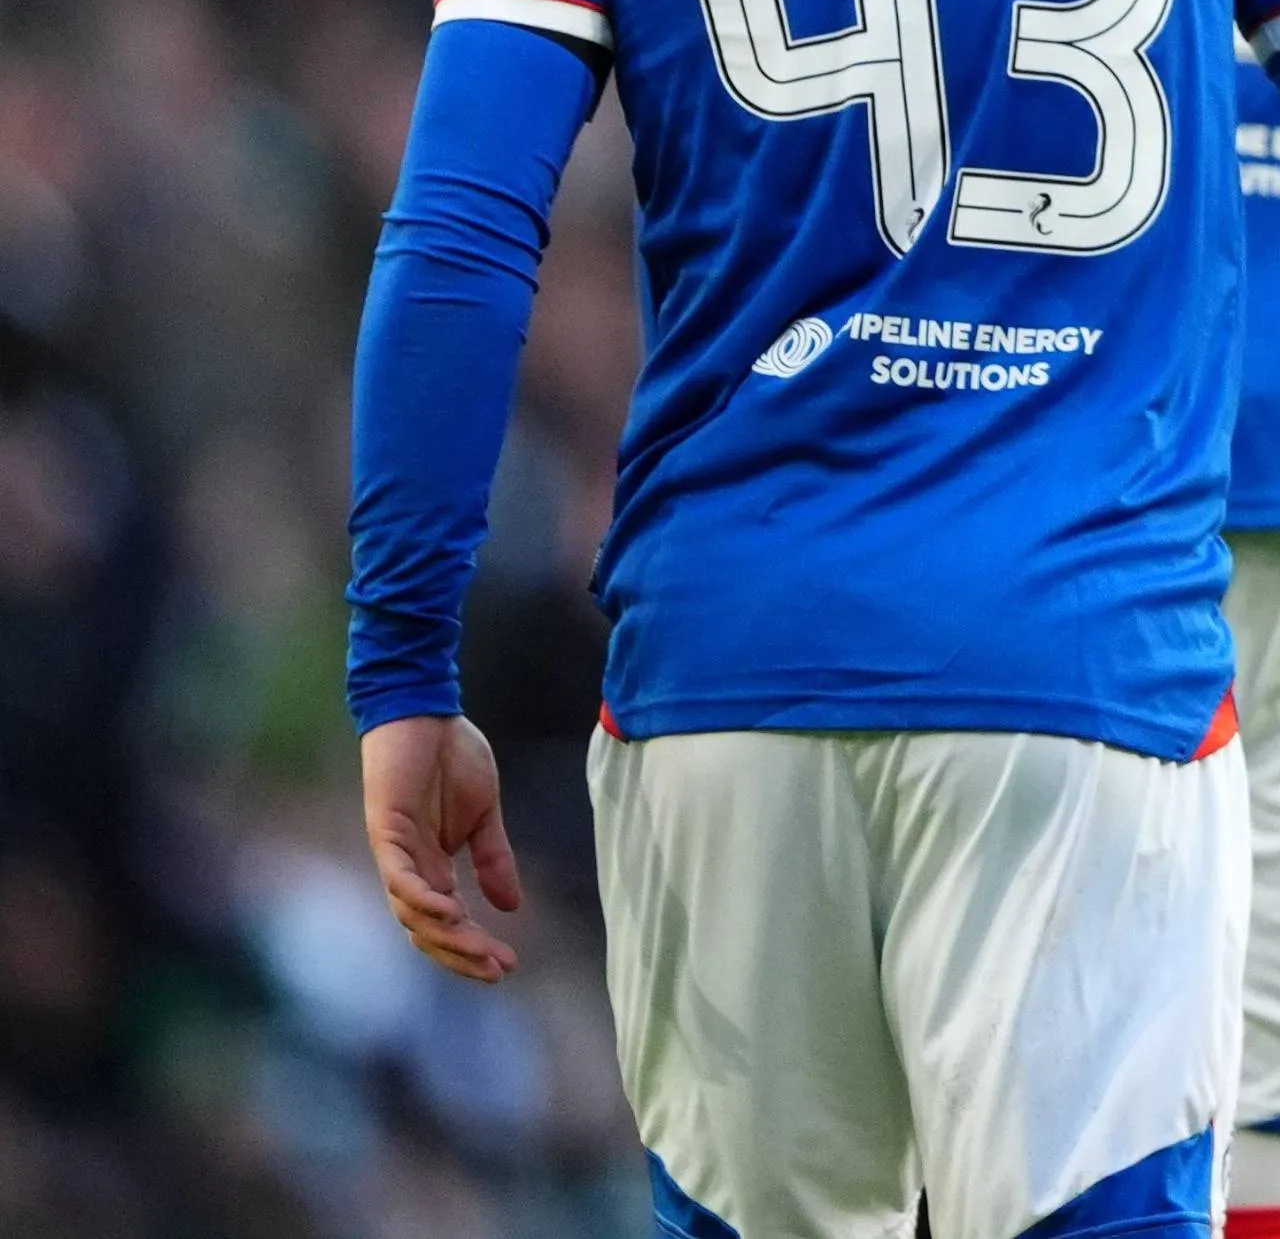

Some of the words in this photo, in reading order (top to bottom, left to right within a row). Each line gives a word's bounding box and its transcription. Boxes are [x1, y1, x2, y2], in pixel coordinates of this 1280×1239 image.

[838, 313, 971, 350] IPELINE
[974, 324, 1103, 355] ENERGY
[870, 356, 1049, 392] SOLUTIONS
